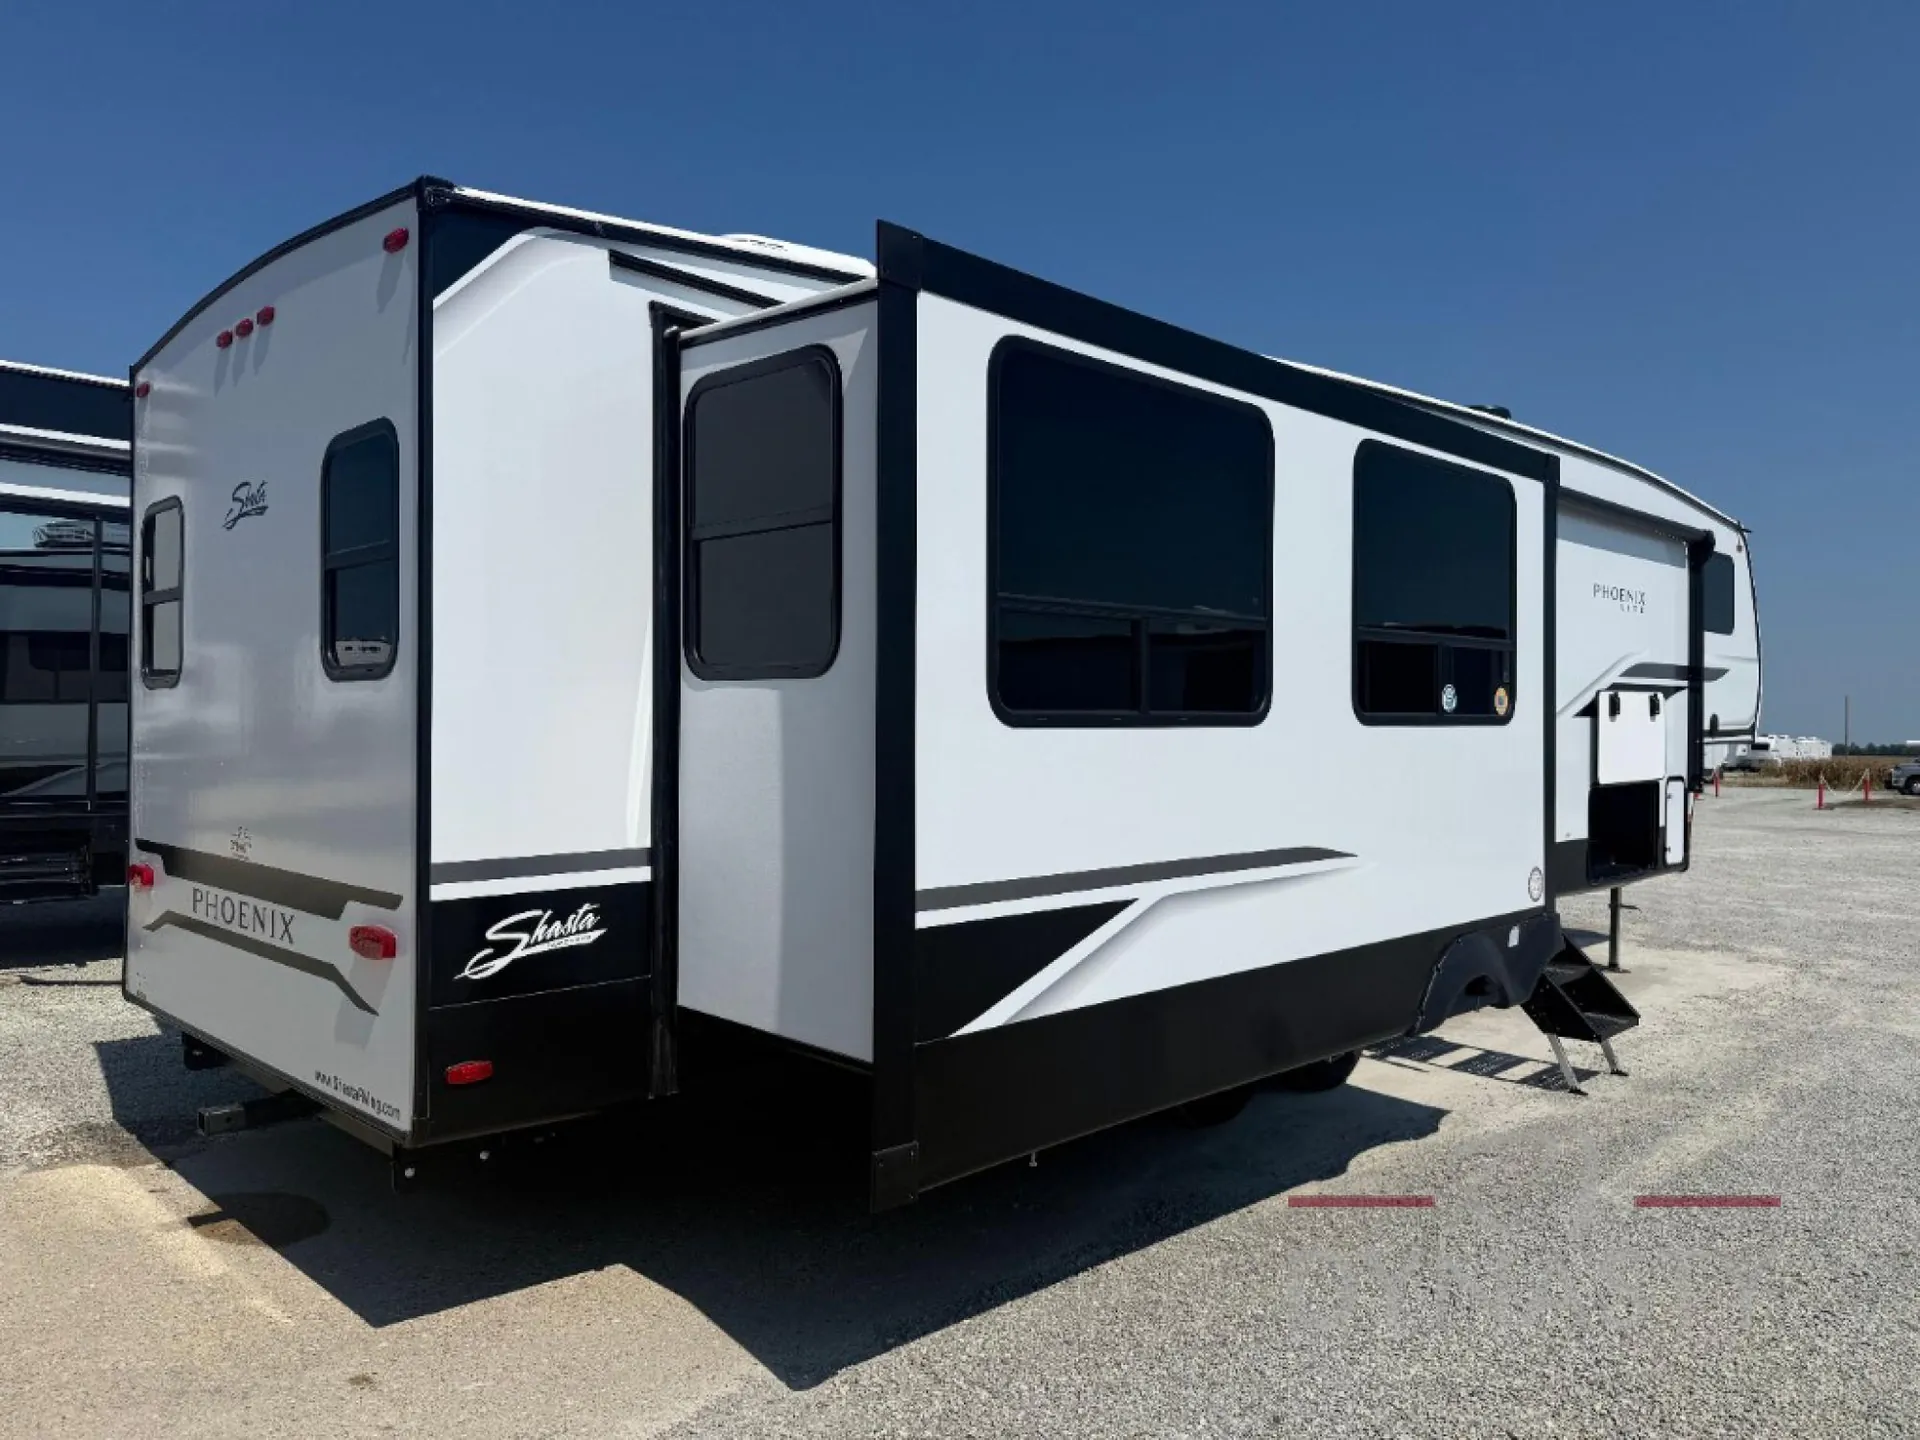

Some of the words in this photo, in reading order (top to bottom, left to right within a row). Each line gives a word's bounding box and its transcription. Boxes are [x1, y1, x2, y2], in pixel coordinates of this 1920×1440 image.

[1593, 582, 1646, 606] PHOENIX
[192, 886, 295, 945] PHOENIX
[452, 903, 608, 980] Shasta
